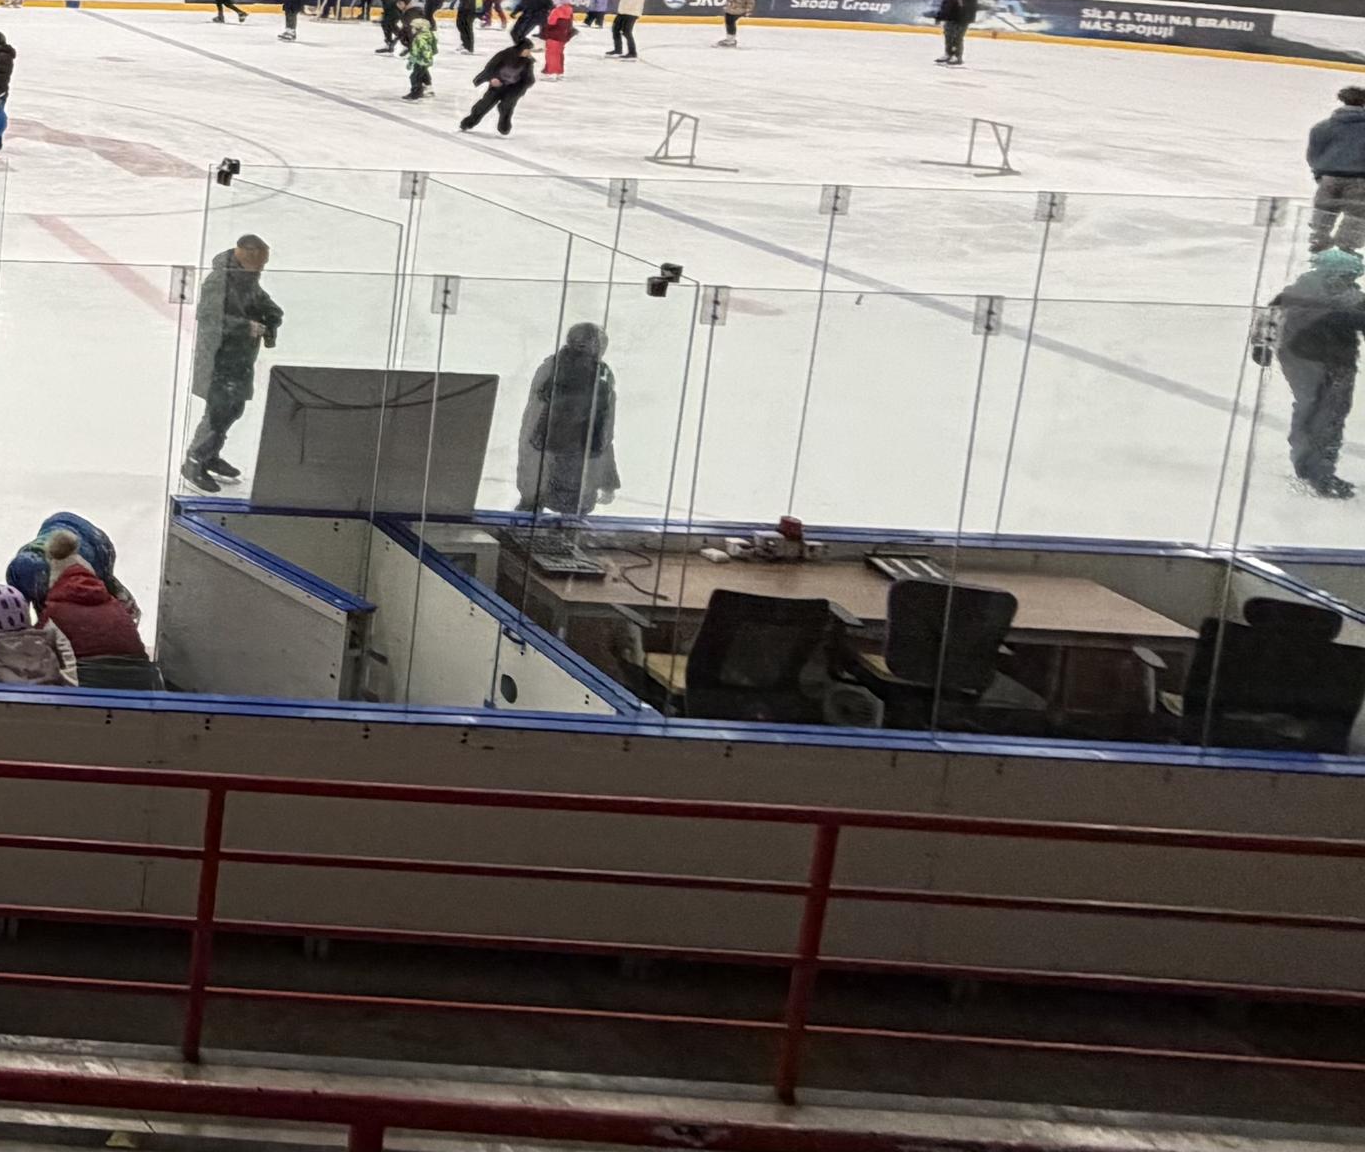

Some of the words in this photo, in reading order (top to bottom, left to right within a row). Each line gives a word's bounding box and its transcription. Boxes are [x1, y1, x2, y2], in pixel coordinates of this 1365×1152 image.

[1079, 19, 1113, 32] NÁS
[1119, 11, 1131, 21] A
[1134, 12, 1166, 24] TAH
[1169, 15, 1192, 27] NA
